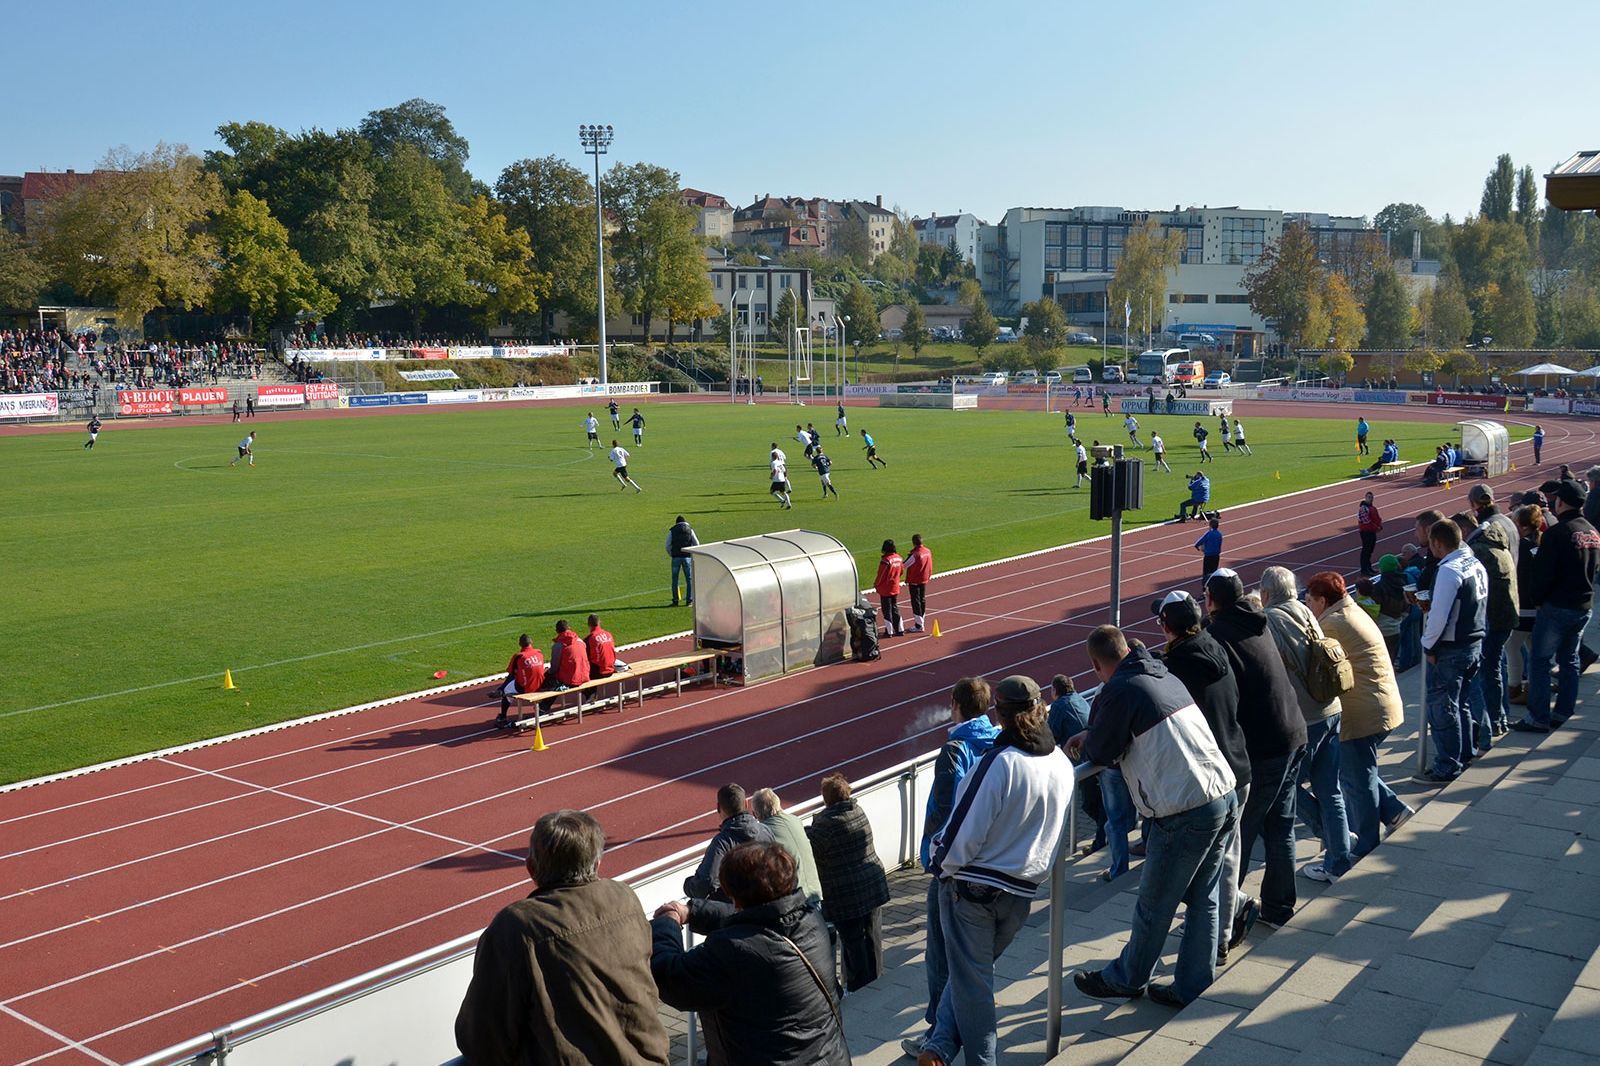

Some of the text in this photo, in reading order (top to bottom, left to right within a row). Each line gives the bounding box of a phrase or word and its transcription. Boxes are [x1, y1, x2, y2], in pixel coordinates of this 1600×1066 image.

[608, 384, 648, 394] BOMBARDIER
[121, 390, 174, 403] A-BLOCK
[182, 391, 224, 401] PLAUEN
[19, 399, 48, 410] MEERANE
